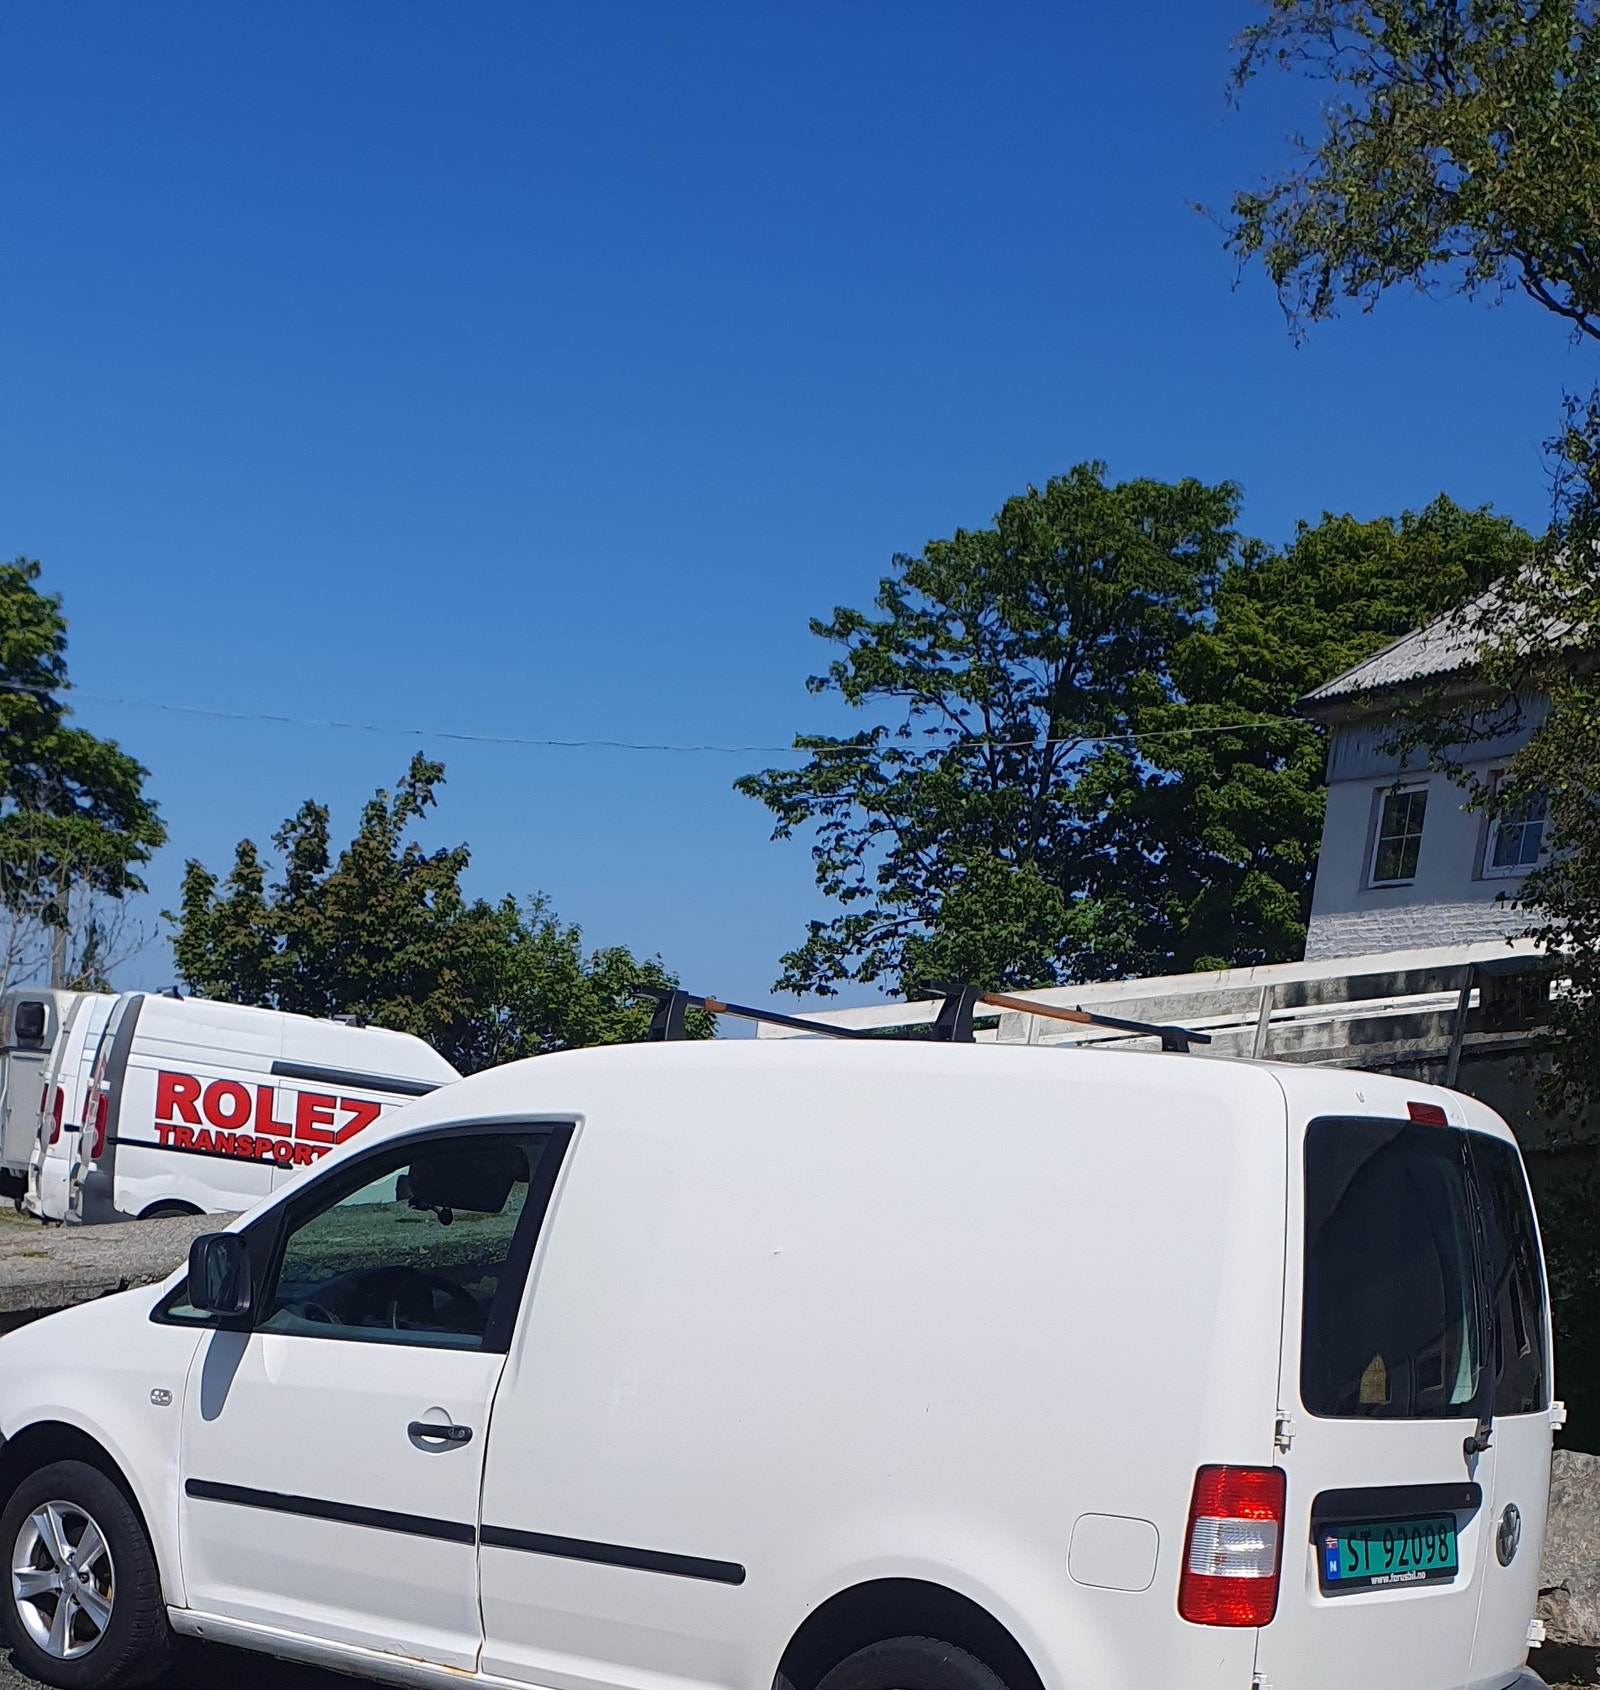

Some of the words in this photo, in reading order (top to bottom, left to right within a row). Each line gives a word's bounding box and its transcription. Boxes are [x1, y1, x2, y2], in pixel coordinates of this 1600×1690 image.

[1347, 1532, 1371, 1571] ST
[1383, 1524, 1448, 1568] 92098
[1330, 1561, 1337, 1572] N
